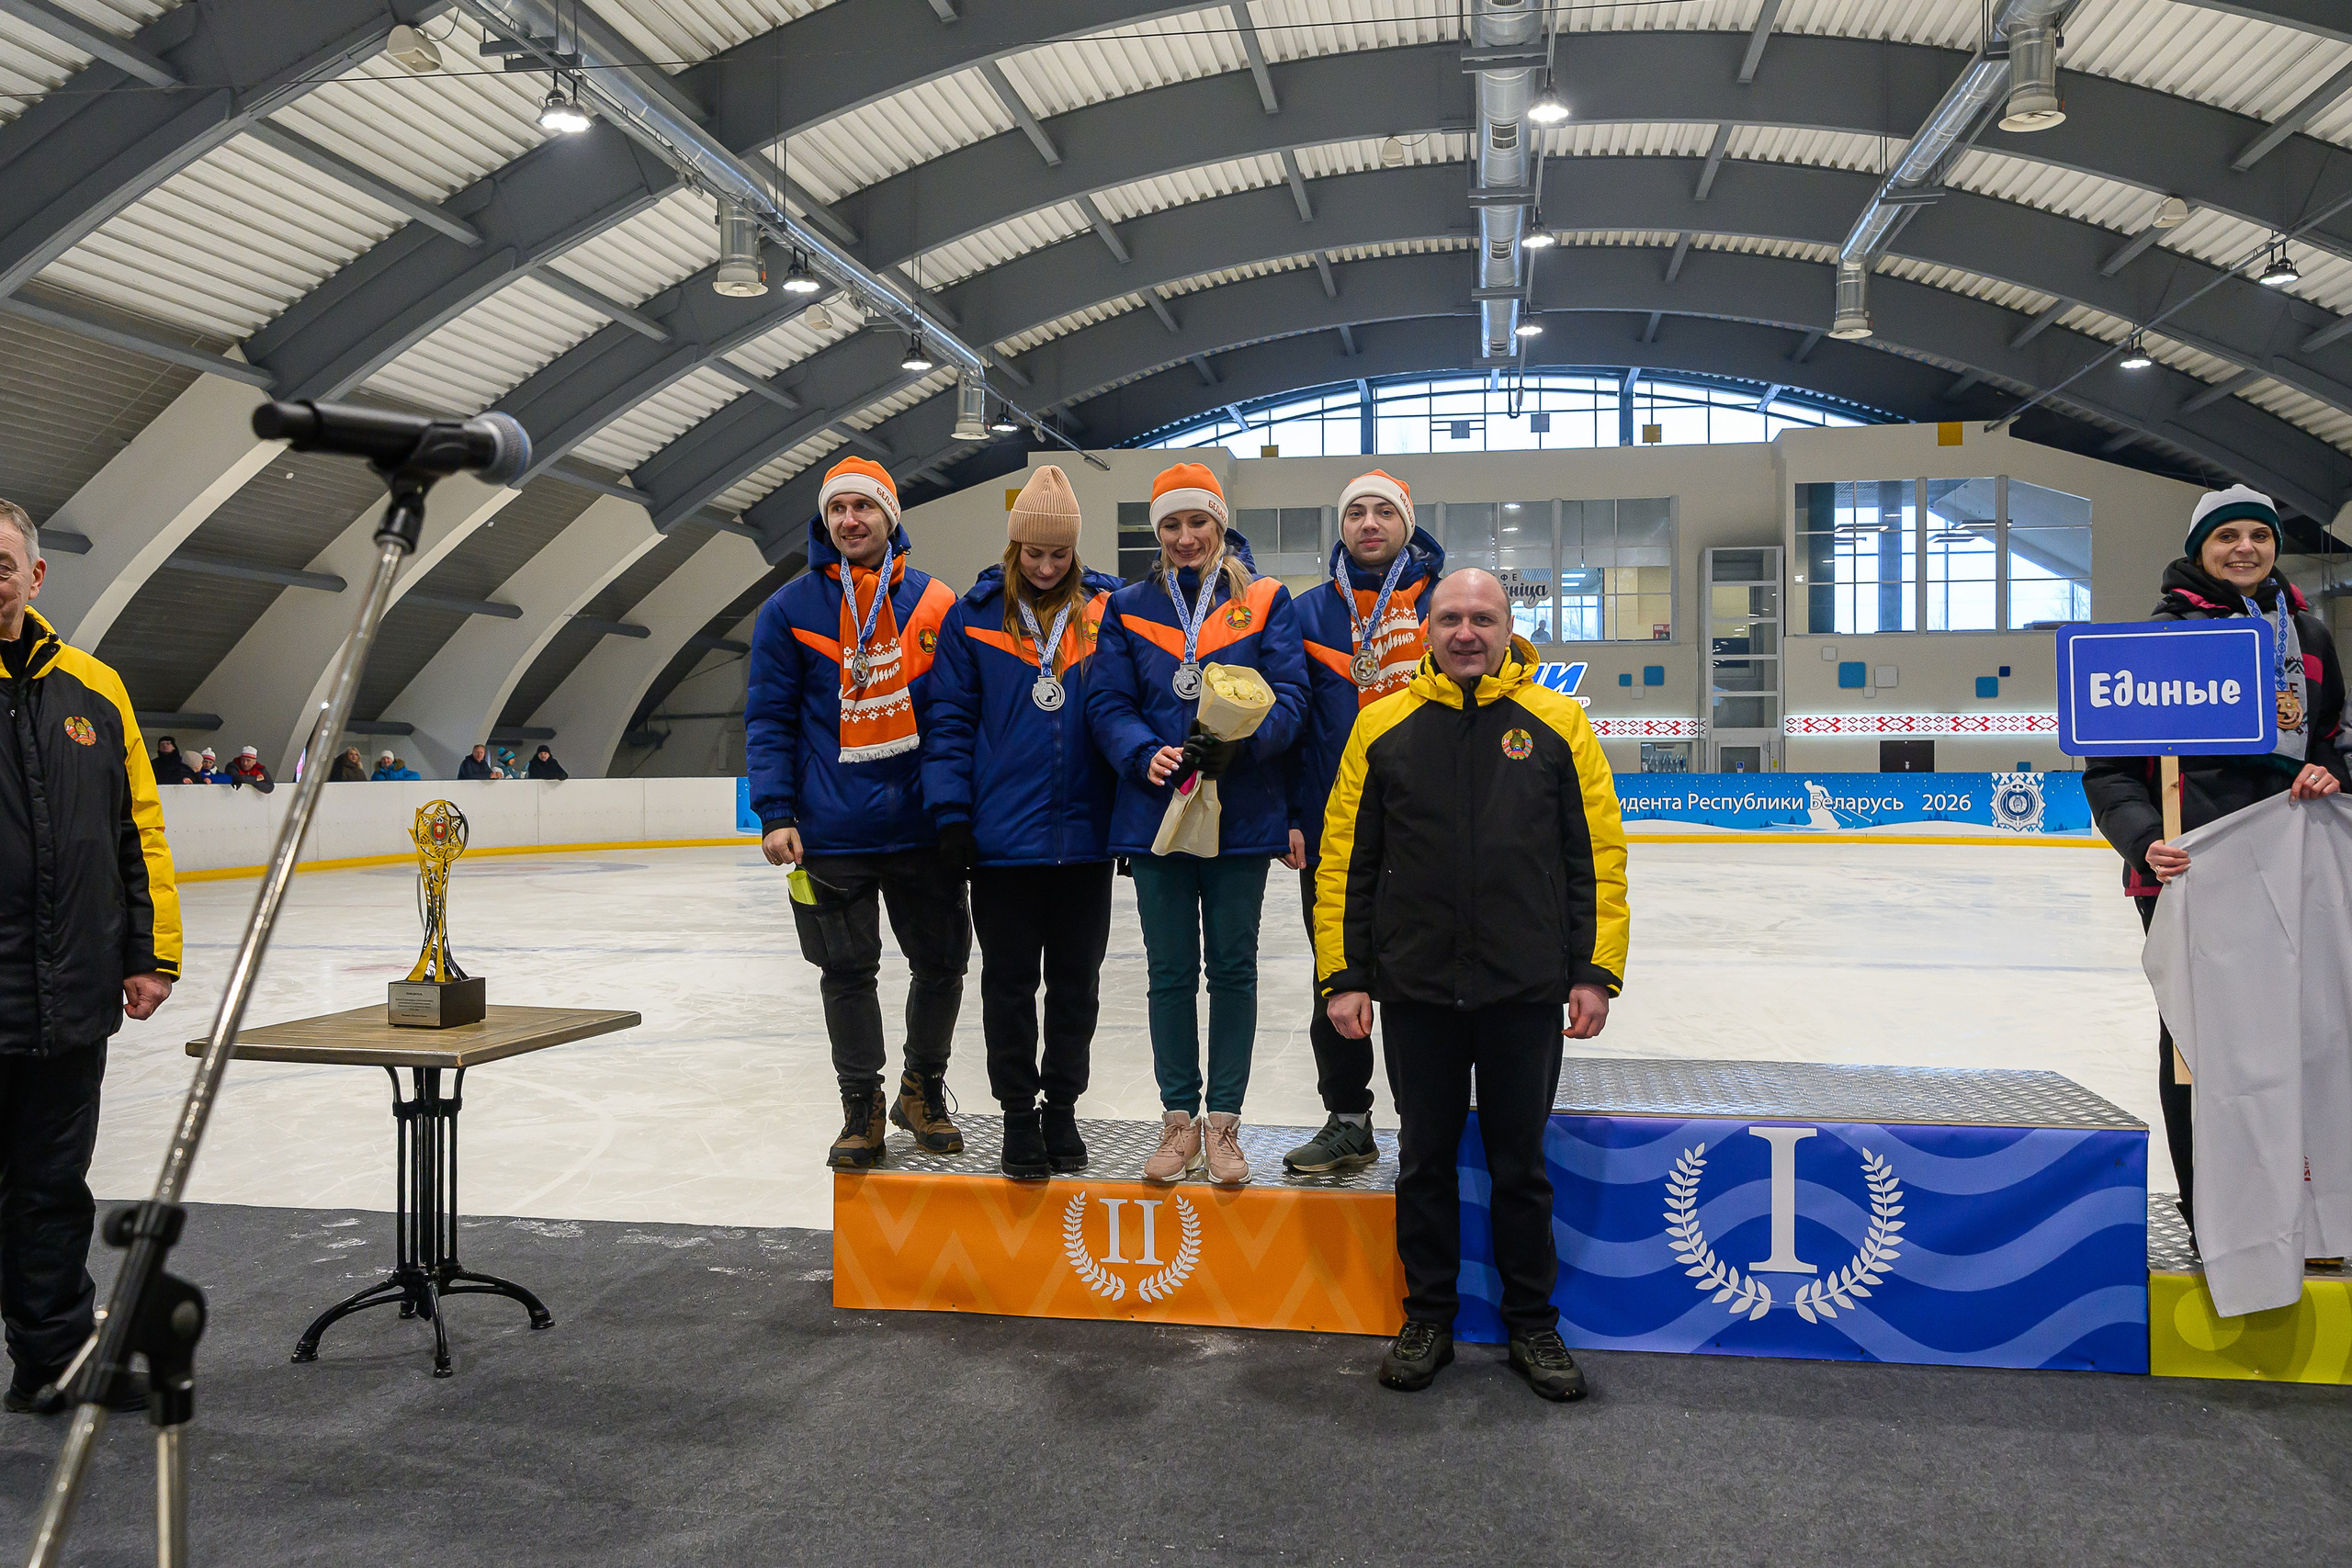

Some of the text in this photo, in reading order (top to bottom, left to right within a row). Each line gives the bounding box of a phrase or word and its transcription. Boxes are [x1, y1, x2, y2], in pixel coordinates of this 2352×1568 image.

[1499, 573, 1518, 582] ФЕ
[1504, 582, 1549, 605] ніца
[2090, 669, 2242, 708] Единые
[1619, 792, 1972, 815] идента Республики Беларусь 2026
